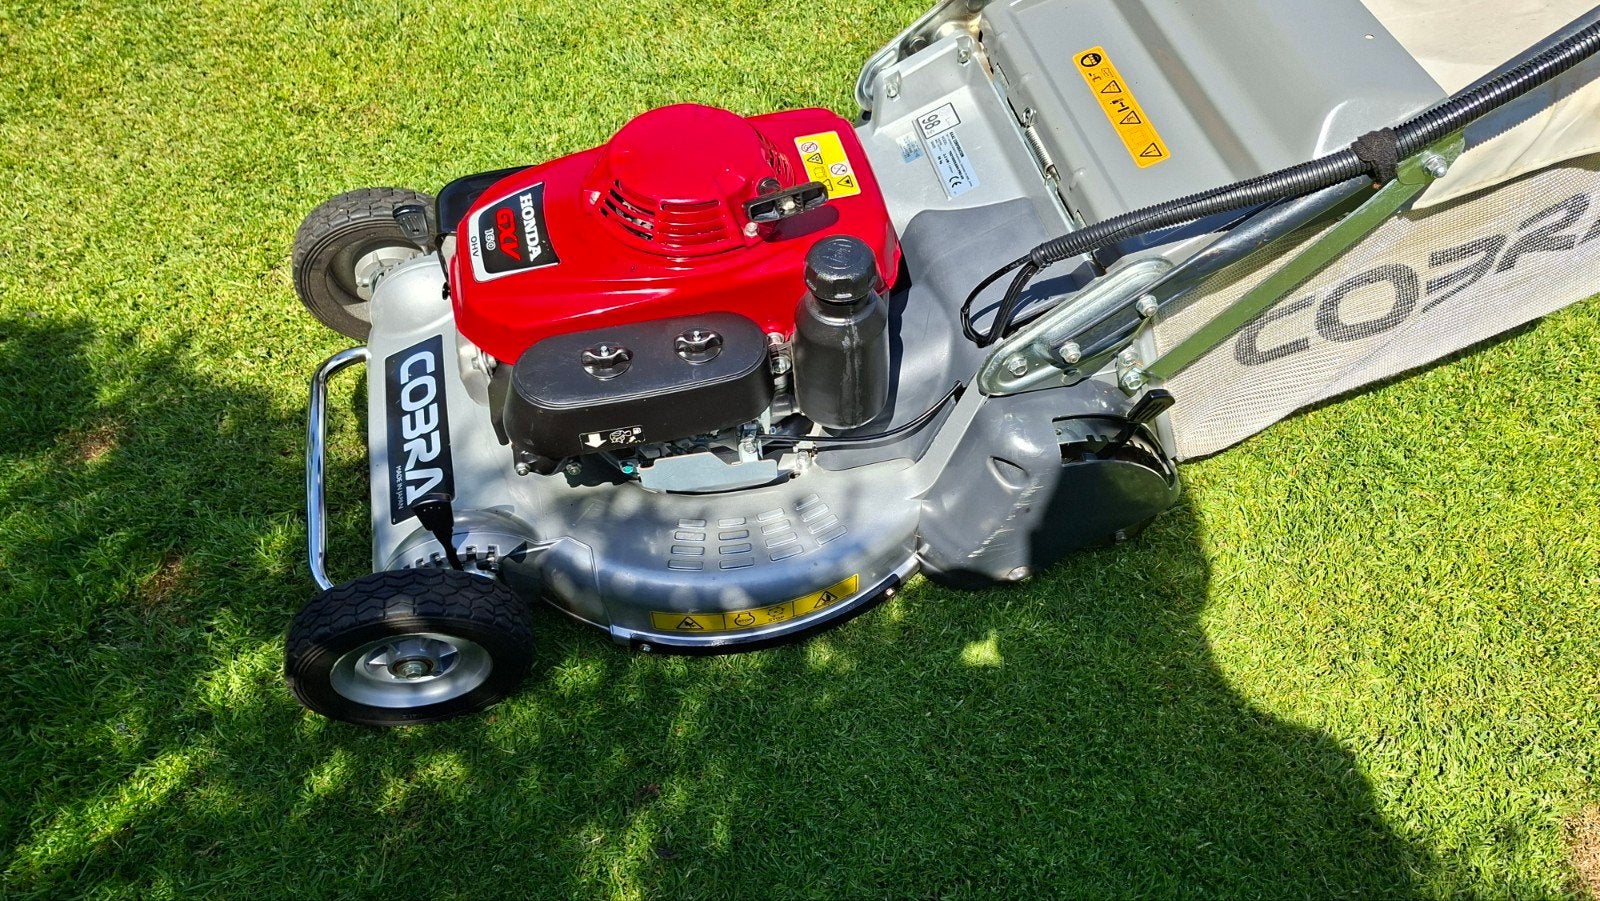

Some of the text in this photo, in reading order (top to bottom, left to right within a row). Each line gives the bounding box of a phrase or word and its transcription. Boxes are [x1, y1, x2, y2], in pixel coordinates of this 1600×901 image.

[922, 114, 941, 130] 98
[470, 236, 479, 257] OHV
[485, 228, 496, 251] 160
[496, 207, 521, 260] GXV
[520, 193, 541, 262] HONDA
[400, 351, 443, 506] COBRA
